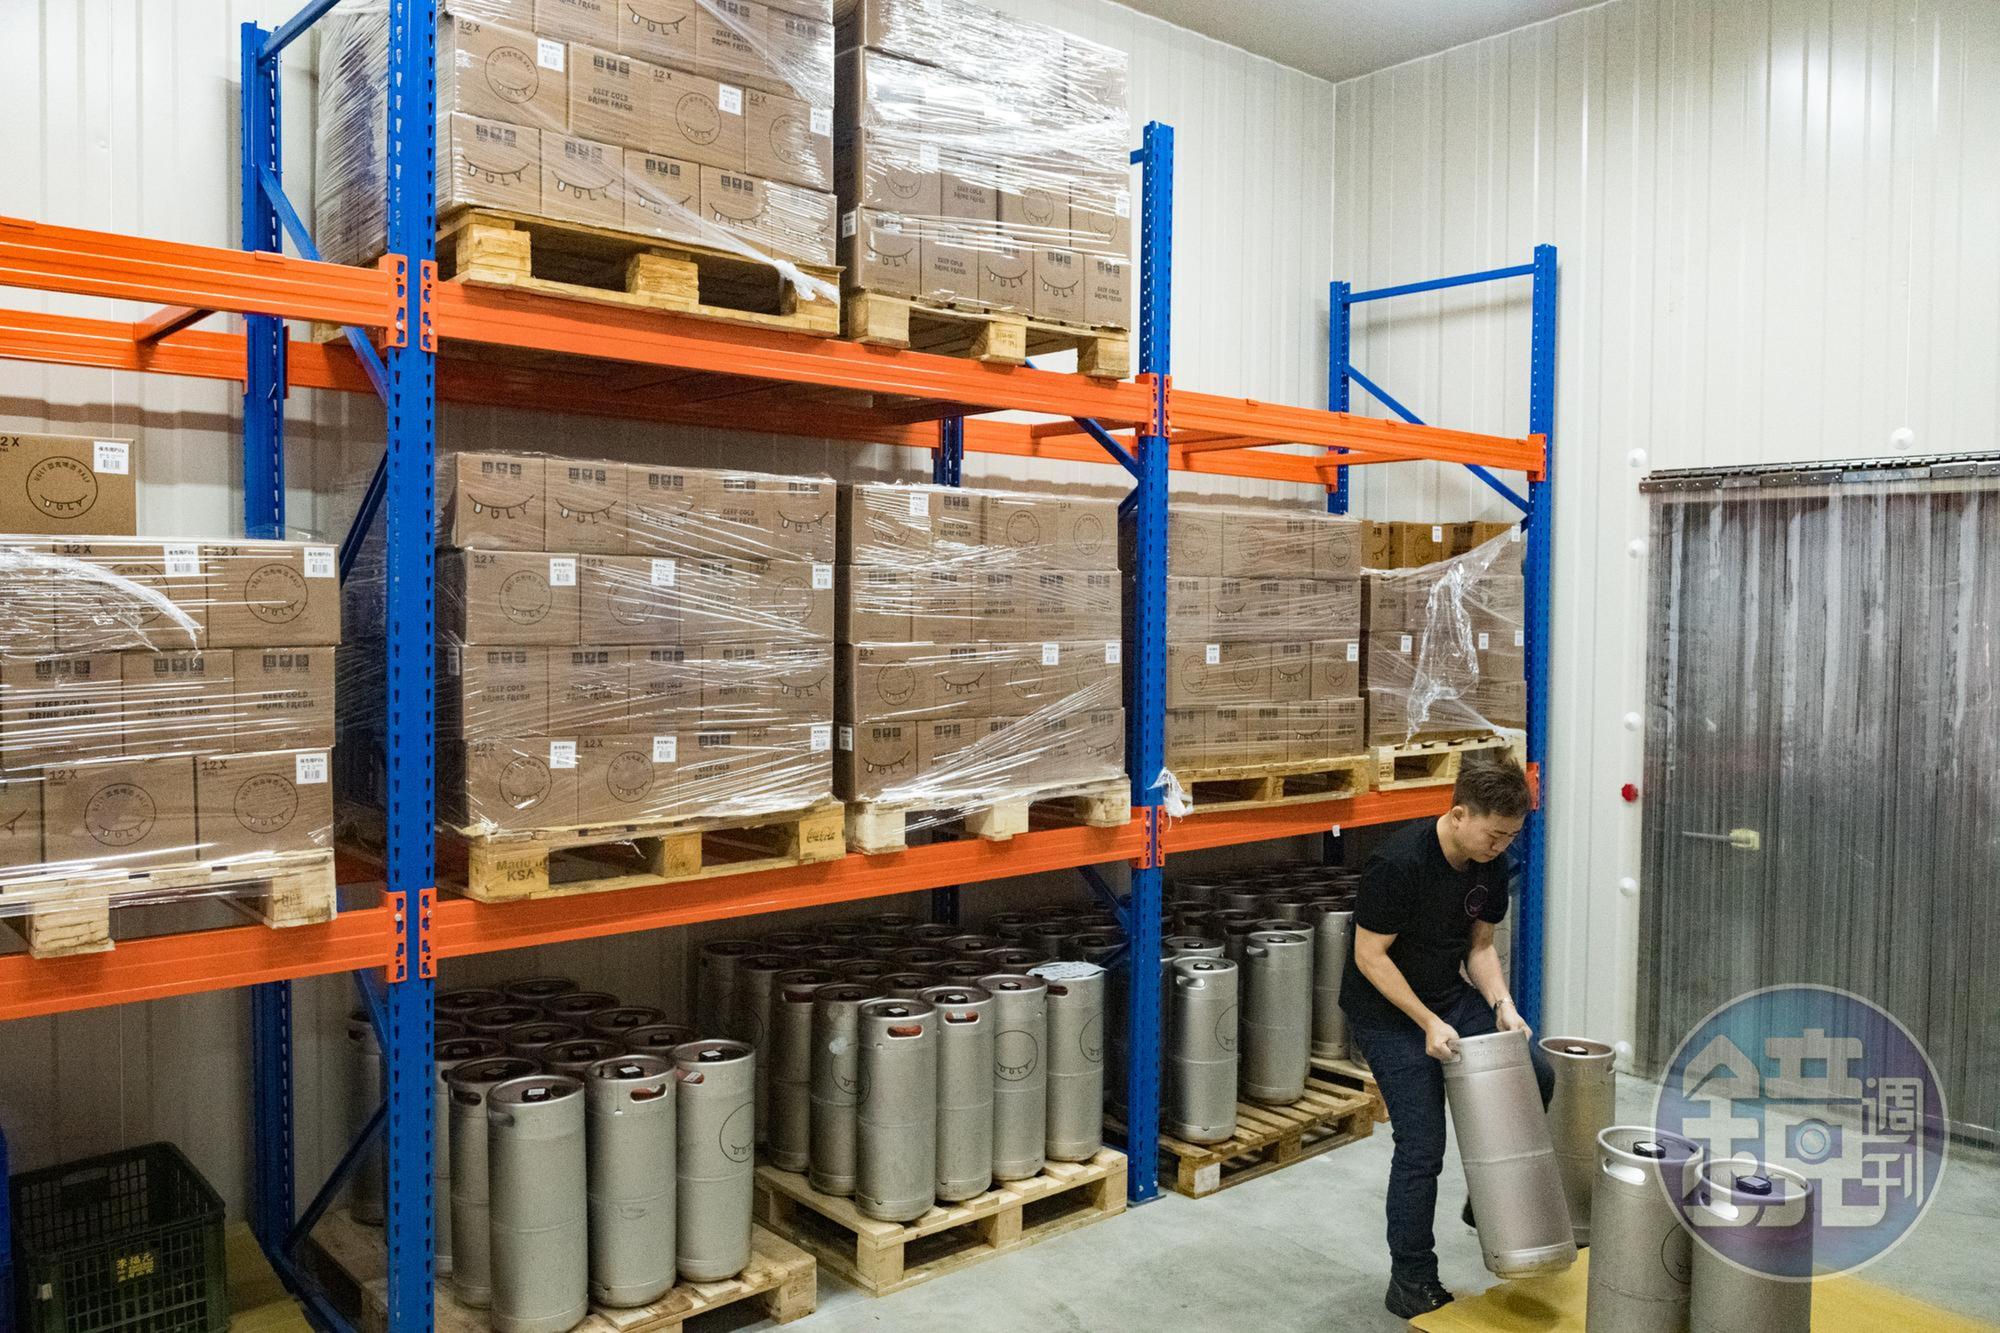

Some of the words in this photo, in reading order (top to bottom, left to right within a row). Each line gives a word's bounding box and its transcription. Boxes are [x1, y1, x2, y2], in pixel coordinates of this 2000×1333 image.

[459, 20, 472, 30] 12
[468, 164, 522, 186] UGLY
[474, 502, 526, 520] UGLY
[561, 508, 610, 524] UGLY
[63, 545, 80, 554] 12
[584, 740, 596, 748] 12
[202, 761, 217, 770] 12
[50, 770, 66, 780] 12
[507, 868, 536, 882] KSA
